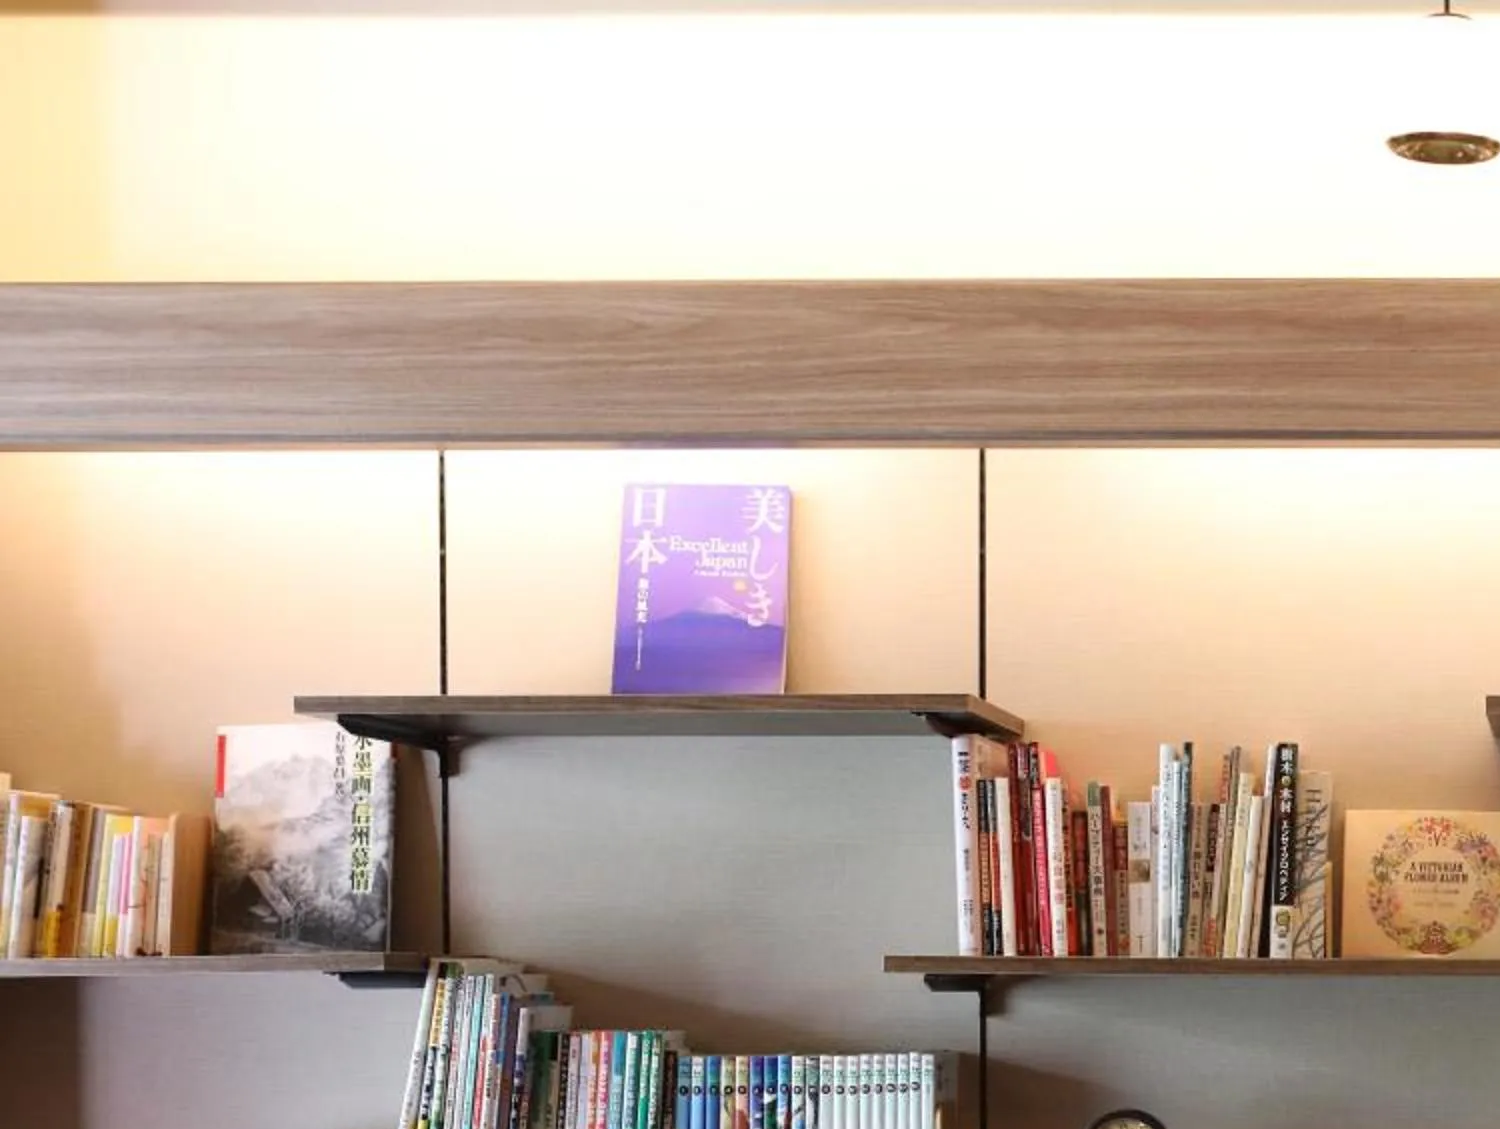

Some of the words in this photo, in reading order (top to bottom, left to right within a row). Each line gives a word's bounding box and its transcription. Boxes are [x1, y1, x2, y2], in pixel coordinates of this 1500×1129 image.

[624, 487, 668, 574] 日本
[669, 534, 748, 553] Excellent
[742, 487, 785, 627] 美しき
[695, 551, 748, 571] Japan
